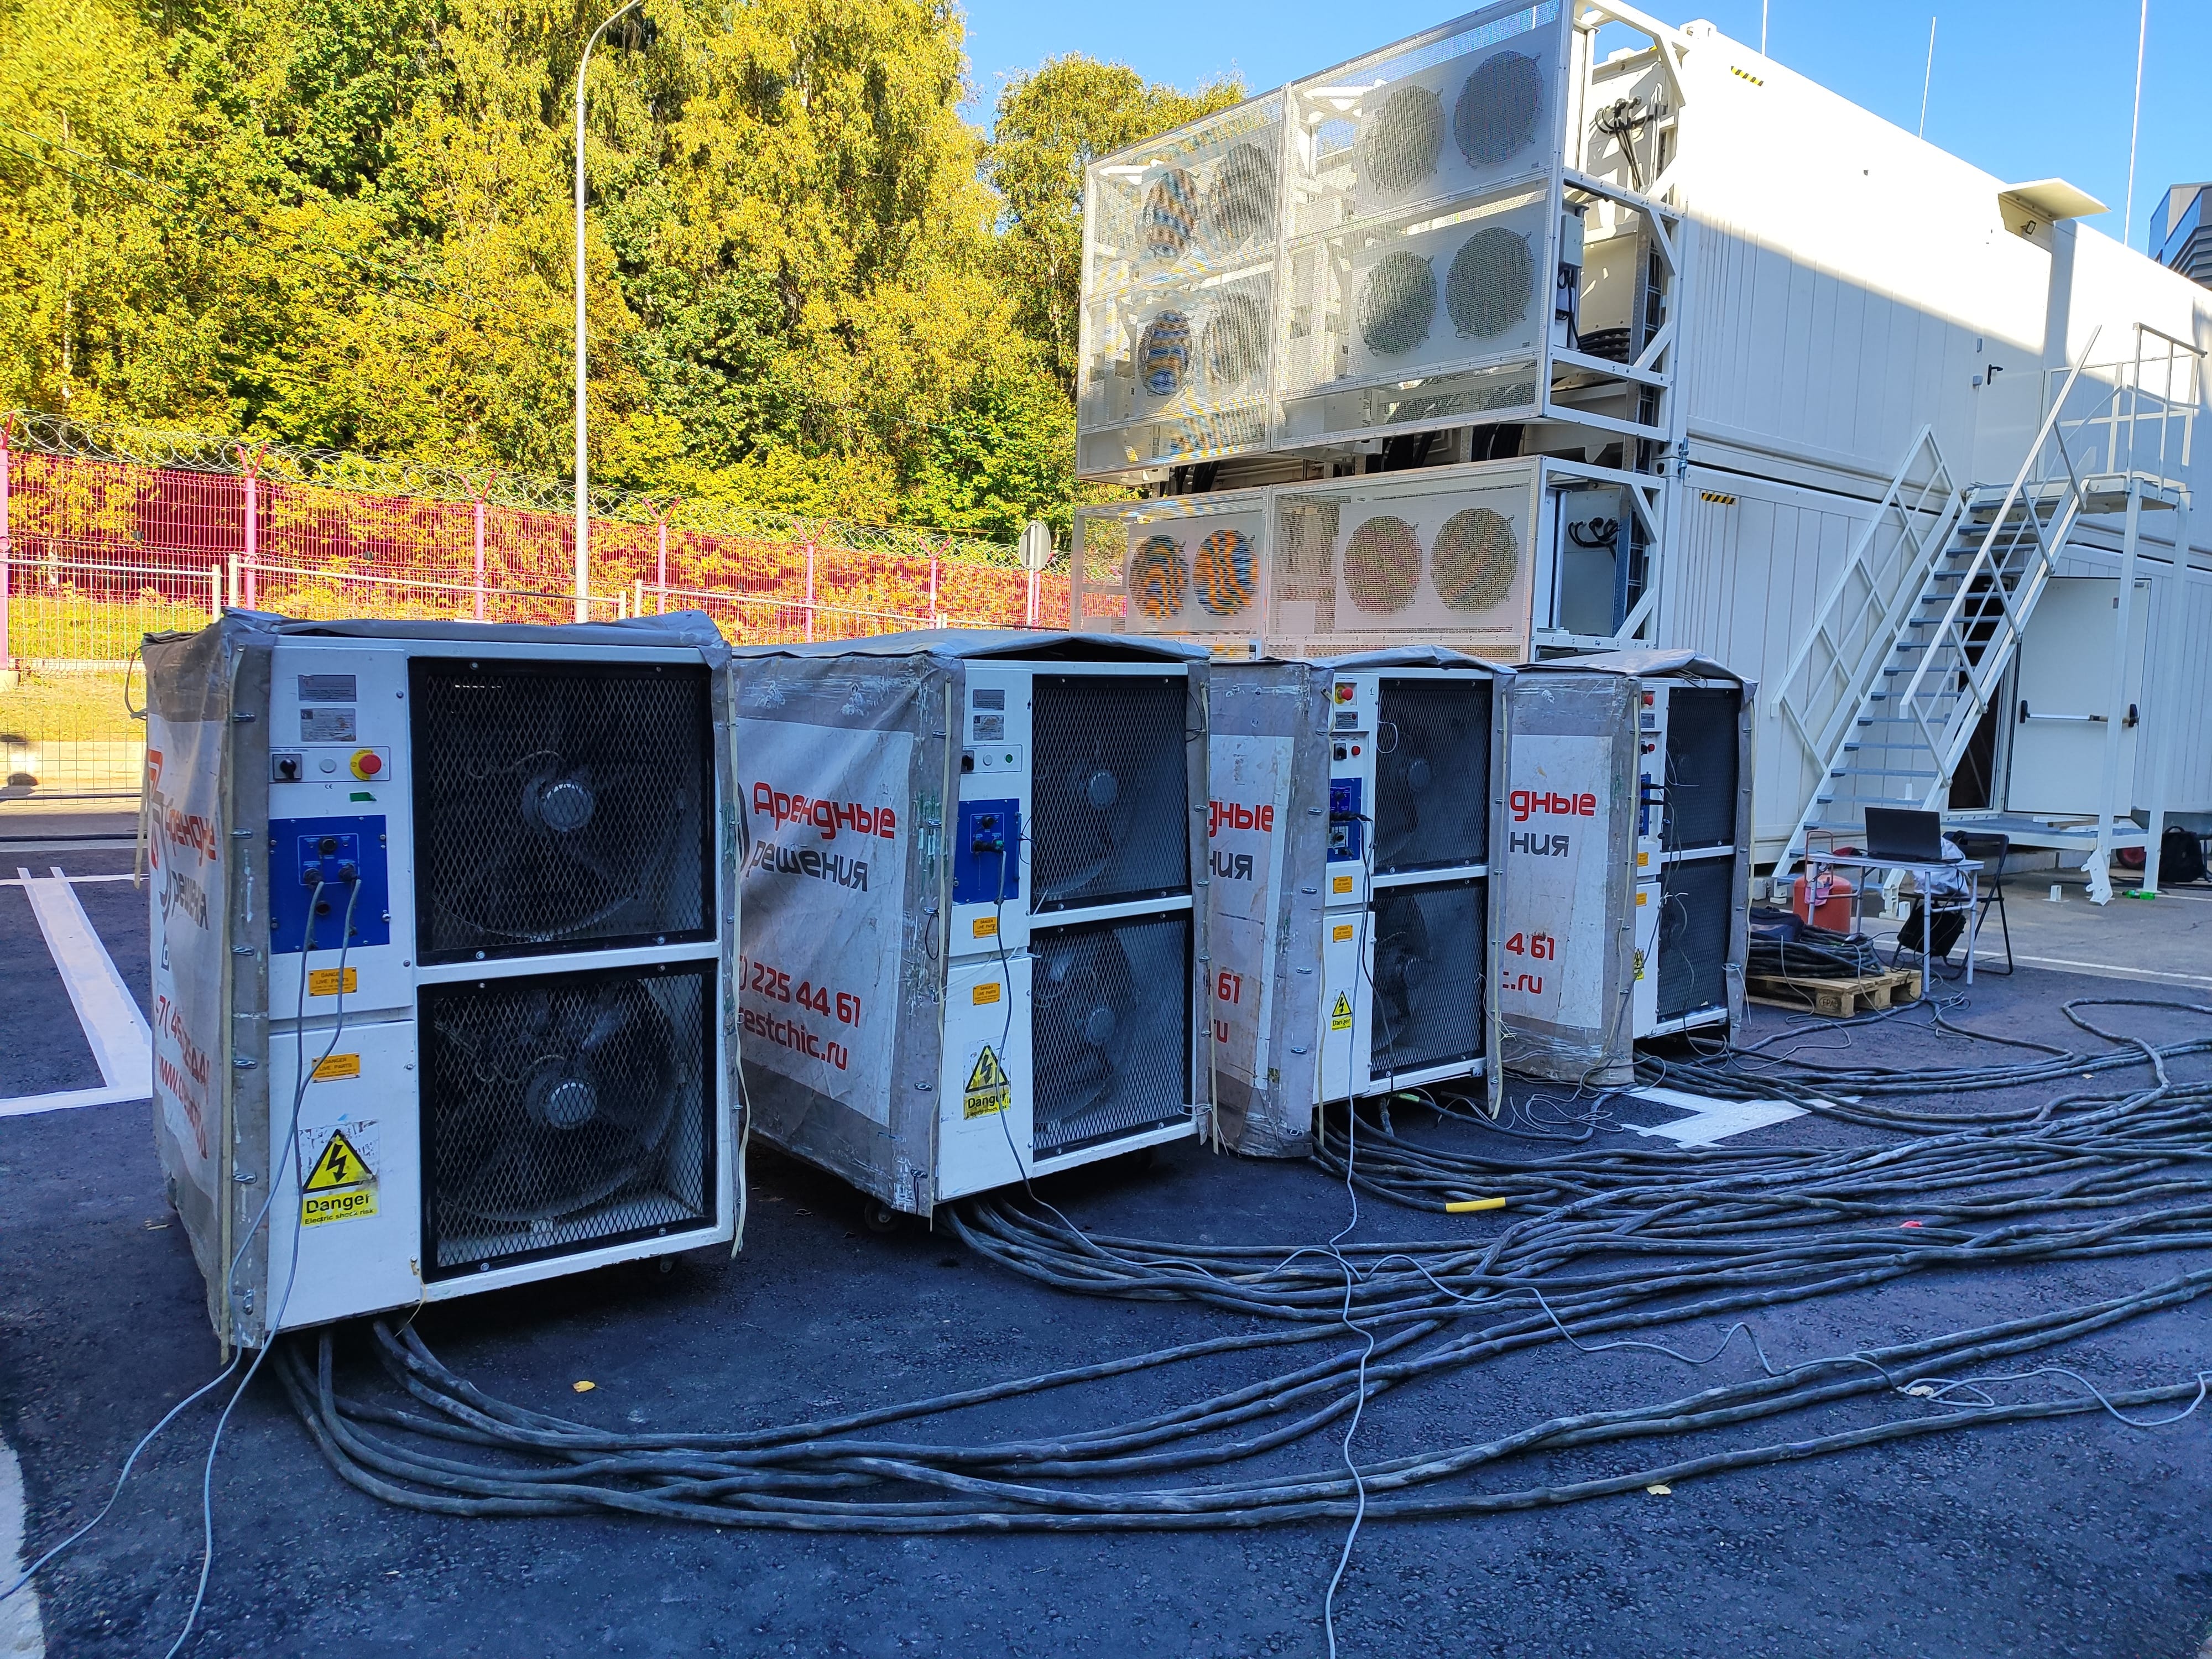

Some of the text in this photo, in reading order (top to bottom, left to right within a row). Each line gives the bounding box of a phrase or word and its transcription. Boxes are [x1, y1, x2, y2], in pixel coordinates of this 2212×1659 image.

[754, 782, 895, 839] Арендные
[1510, 791, 1596, 821] дные
[1510, 832, 1569, 857] ния
[746, 840, 868, 892] решения
[1504, 933, 1554, 961] 4 61
[752, 962, 790, 1003] 225
[796, 982, 831, 1016] 44
[836, 992, 860, 1027] 61
[1218, 973, 1240, 1004] 61
[305, 1215, 333, 1224] Electric
[335, 1211, 358, 1219] shock
[306, 1194, 370, 1213] Danger
